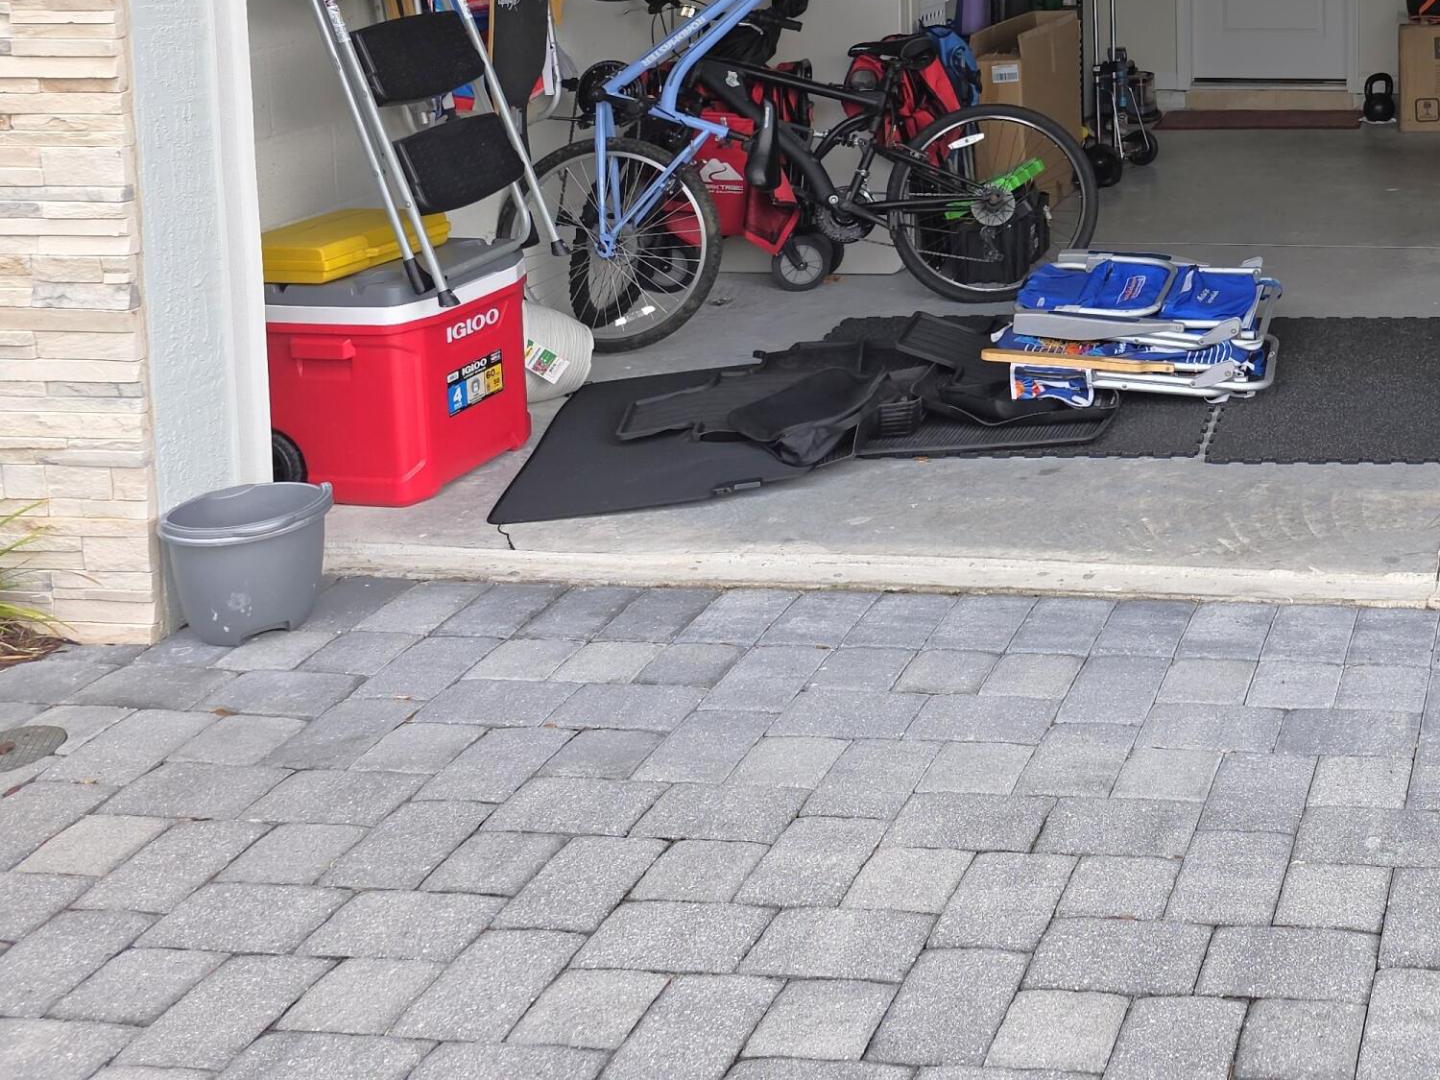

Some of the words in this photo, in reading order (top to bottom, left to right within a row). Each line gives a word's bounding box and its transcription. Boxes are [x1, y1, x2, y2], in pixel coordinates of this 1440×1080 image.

[639, 16, 707, 68] ROADMASTER
[446, 308, 500, 344] IGLOO
[461, 358, 488, 376] IGLOO
[453, 386, 463, 403] 4
